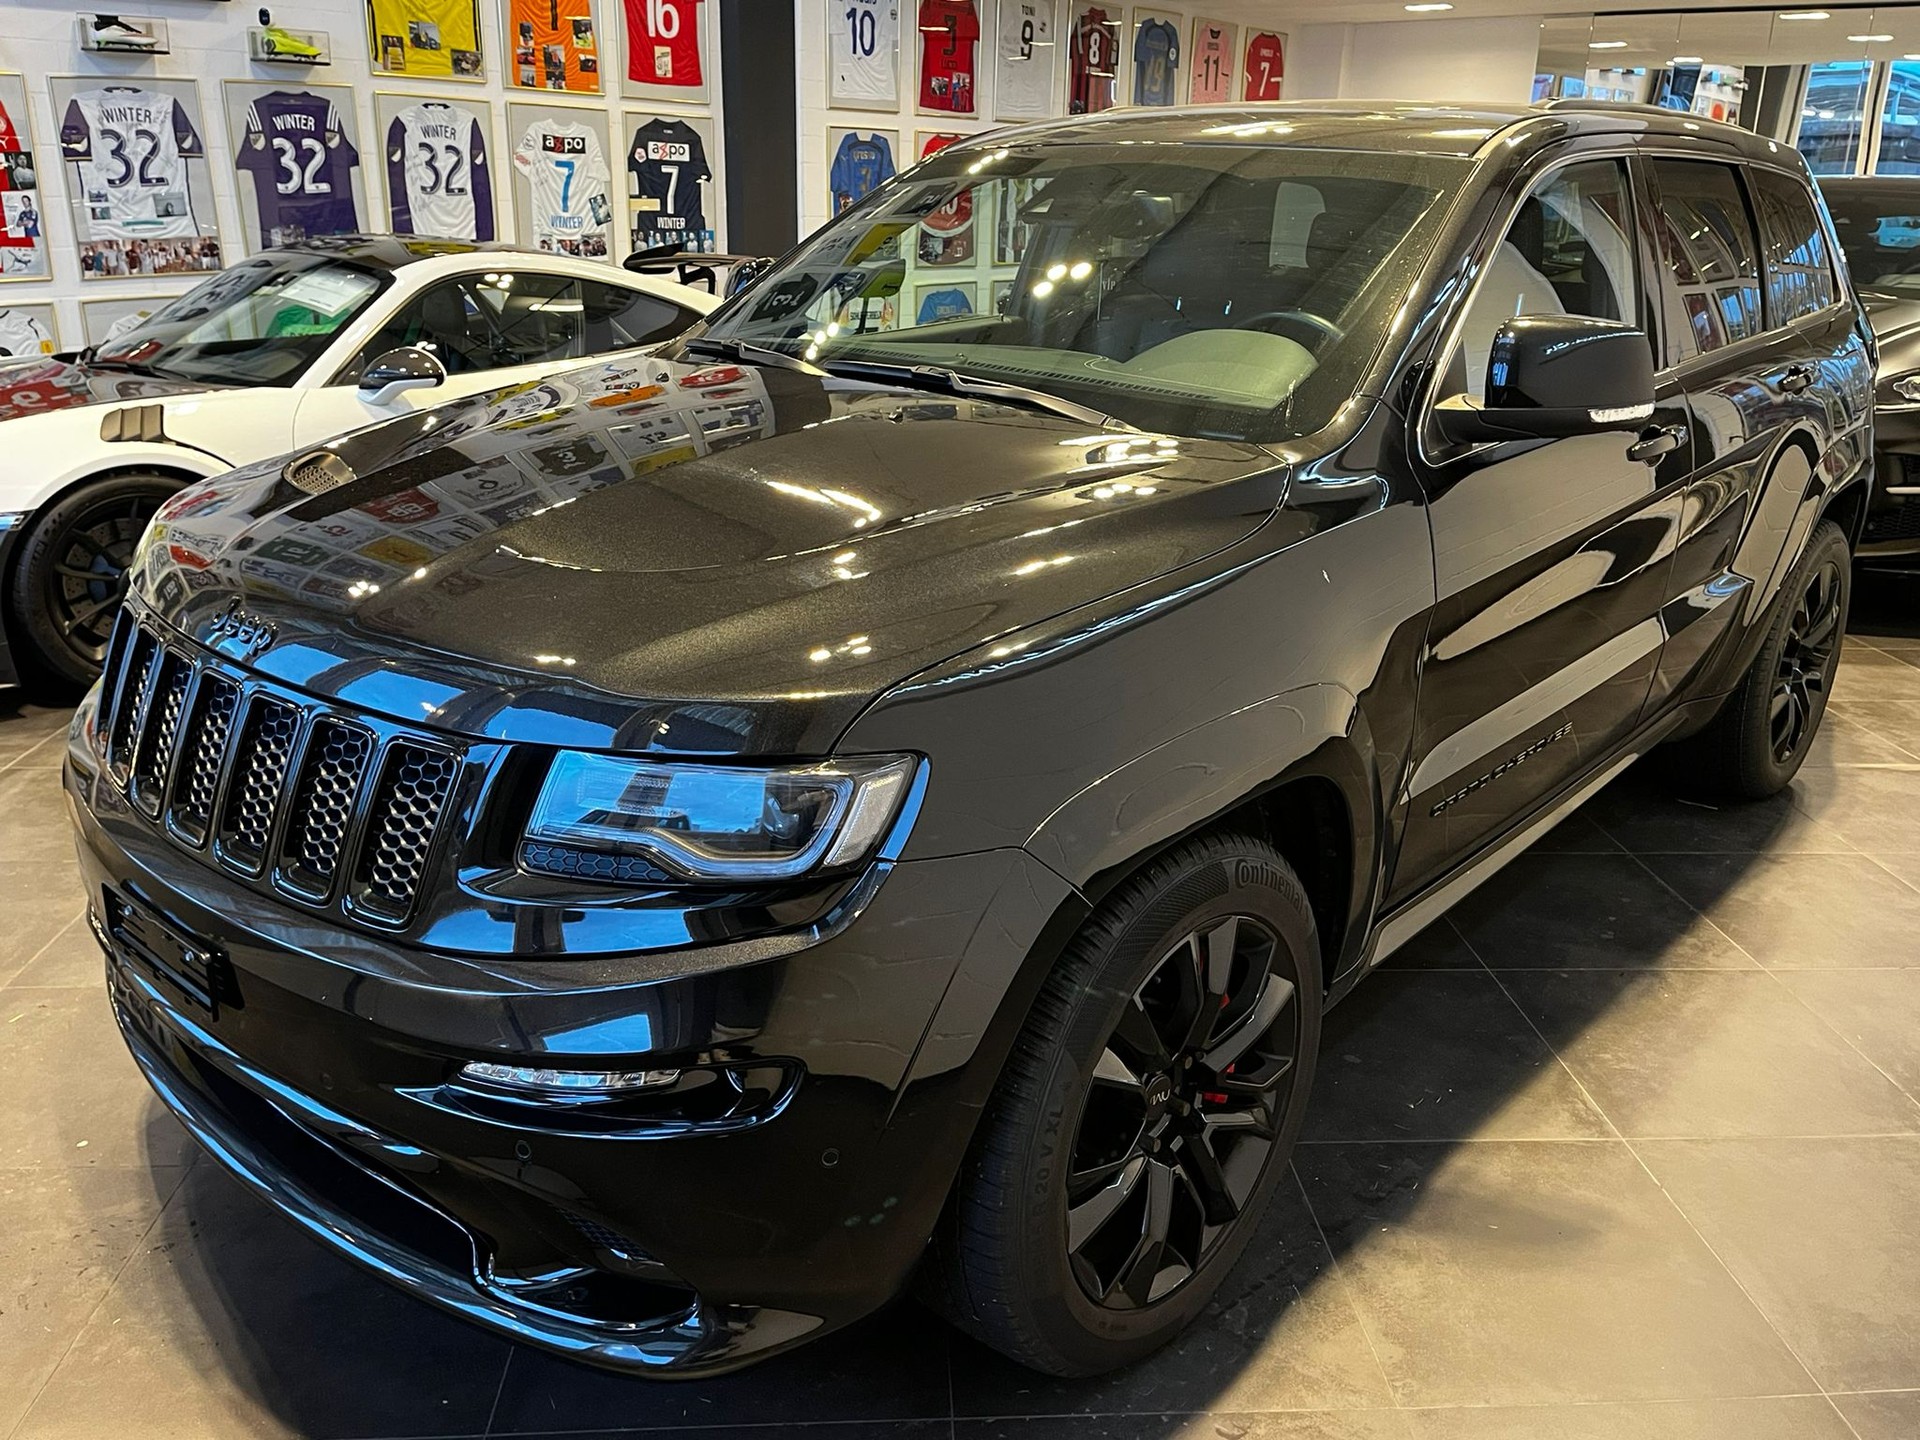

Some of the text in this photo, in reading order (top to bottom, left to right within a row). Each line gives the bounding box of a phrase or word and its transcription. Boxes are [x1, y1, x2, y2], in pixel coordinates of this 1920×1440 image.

[646, 0, 681, 38] 16
[846, 7, 875, 56] 10
[1020, 20, 1034, 60] 9
[1088, 32, 1101, 65] 8
[1203, 55, 1220, 92] 11
[1260, 61, 1271, 97] 7
[101, 106, 152, 125] WINTER
[271, 113, 316, 132] WINTER
[420, 124, 457, 141] WINTER
[100, 129, 170, 188] 32
[271, 137, 332, 195] 32
[418, 142, 468, 196] 32
[554, 161, 576, 213] 7
[660, 165, 680, 215] 7
[551, 215, 584, 230] WINTER
[657, 216, 687, 230] WINTER
[208, 596, 279, 657] Jeep
[1234, 858, 1305, 915] Continental
